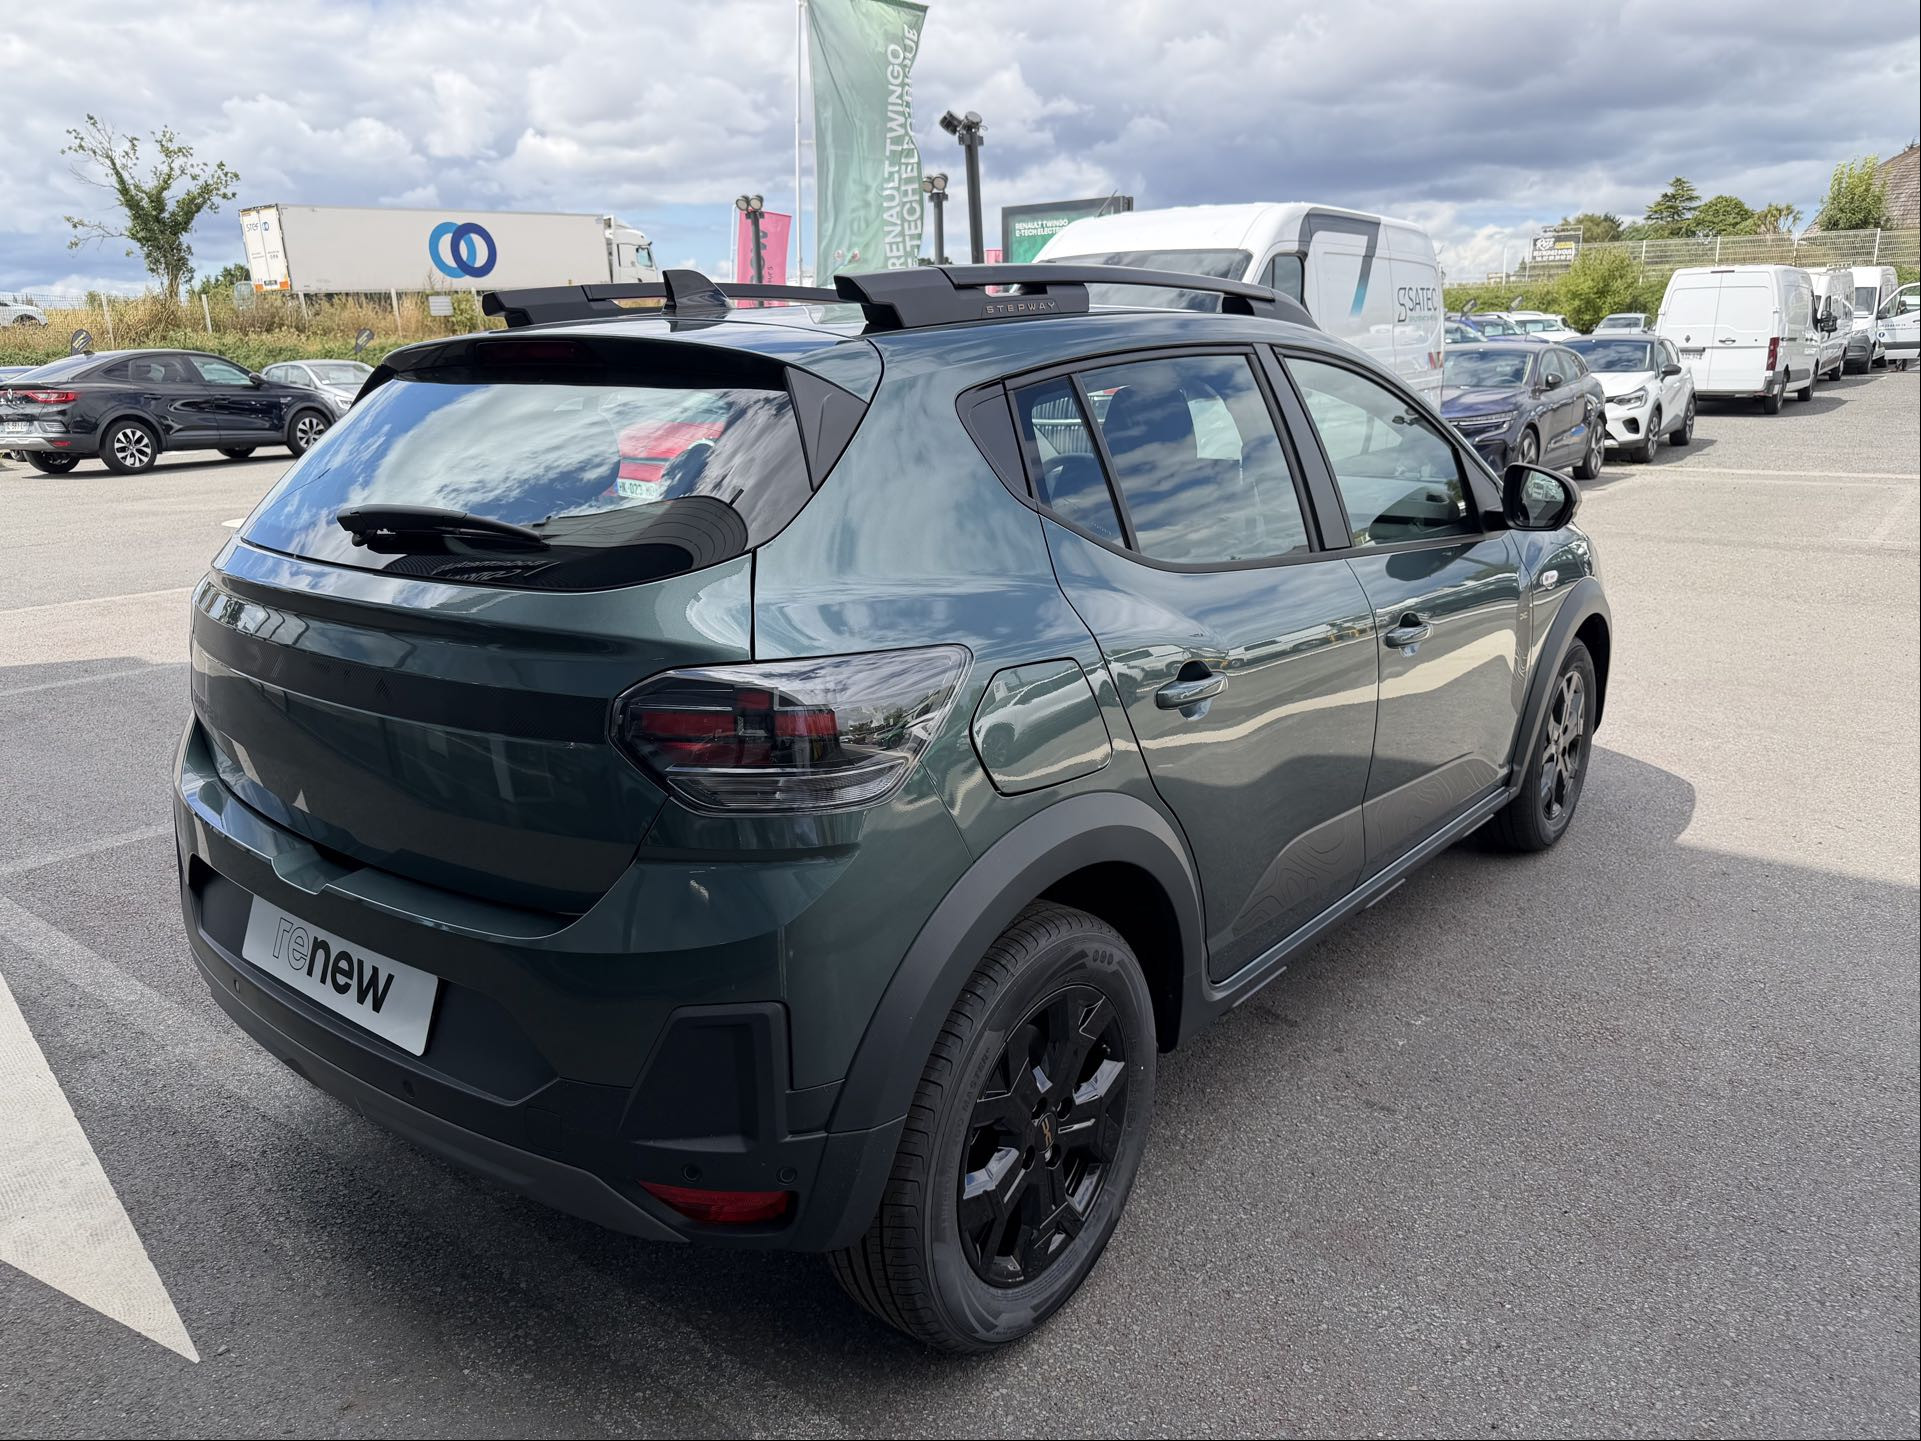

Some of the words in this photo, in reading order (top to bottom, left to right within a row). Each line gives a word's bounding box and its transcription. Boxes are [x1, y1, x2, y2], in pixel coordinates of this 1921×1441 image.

[885, 43, 905, 156] TWINGO
[882, 160, 905, 270] RENAULT
[1015, 221, 1041, 230] RENAULT
[1042, 219, 1069, 228] TWINGO
[1015, 229, 1037, 237] E-TECH
[986, 301, 1055, 314] STEPWAY
[1407, 287, 1438, 312] SATEC
[272, 917, 395, 1014] renew
